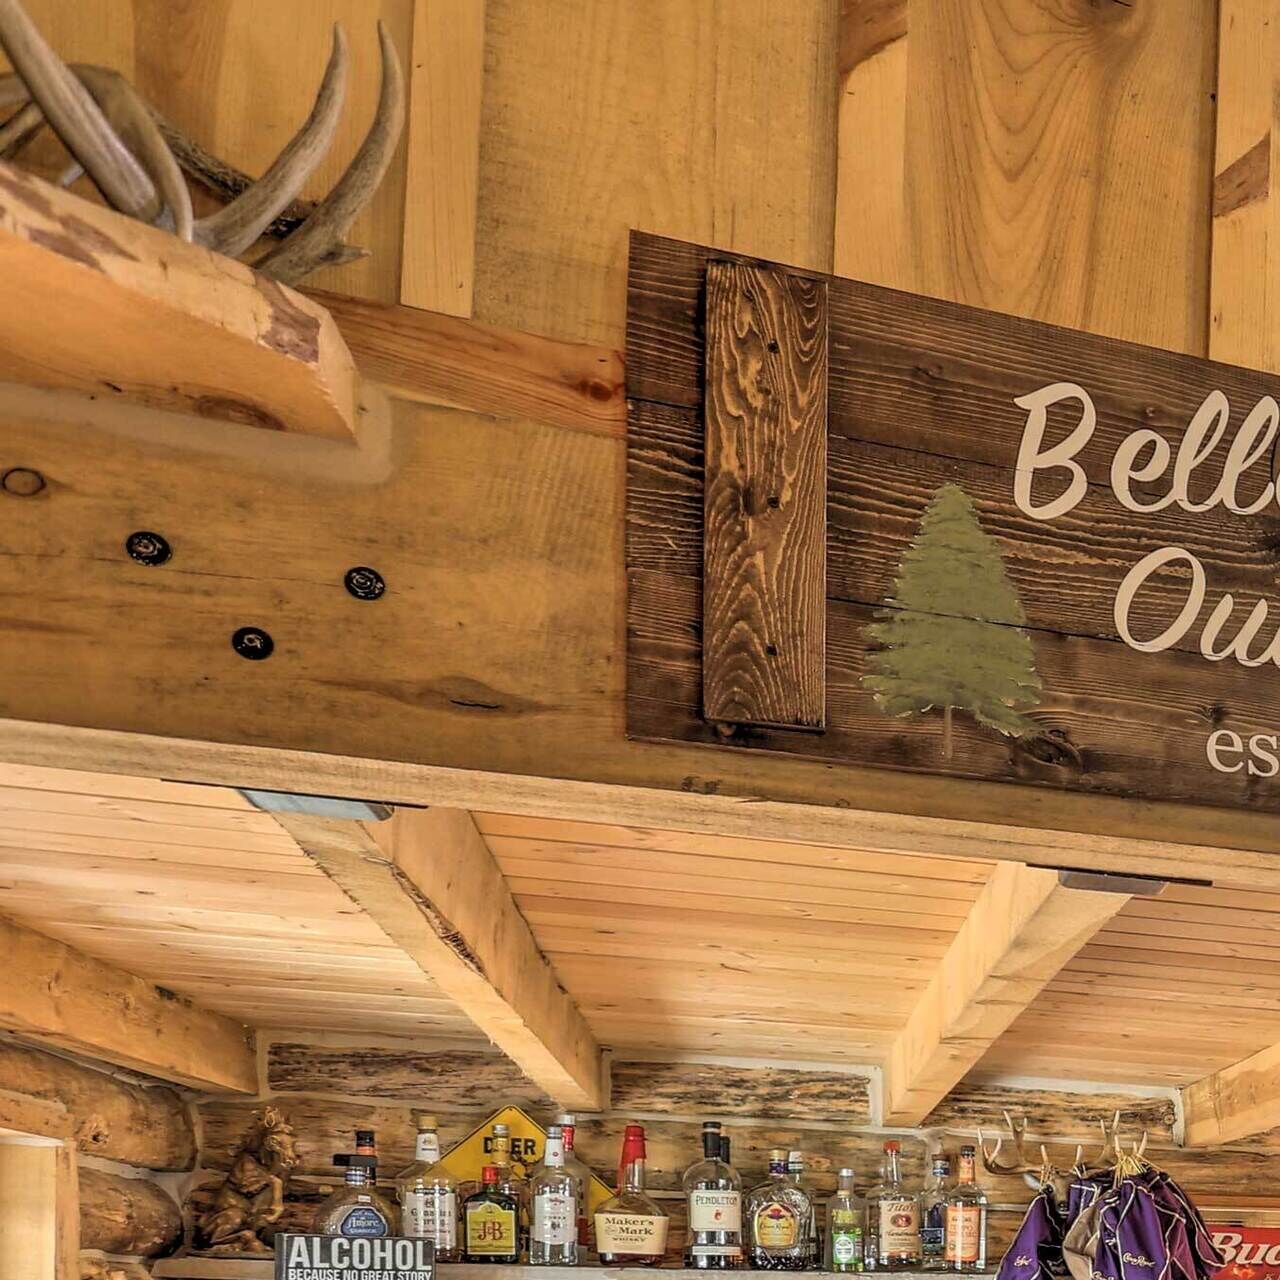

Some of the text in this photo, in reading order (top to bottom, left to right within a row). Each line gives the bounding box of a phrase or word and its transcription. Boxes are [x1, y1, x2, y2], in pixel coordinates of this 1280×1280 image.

[483, 1137, 536, 1156] DER
[604, 1217, 654, 1226] Maker's
[618, 1226, 653, 1236] Mark
[288, 1236, 432, 1271] ALCOHOL
